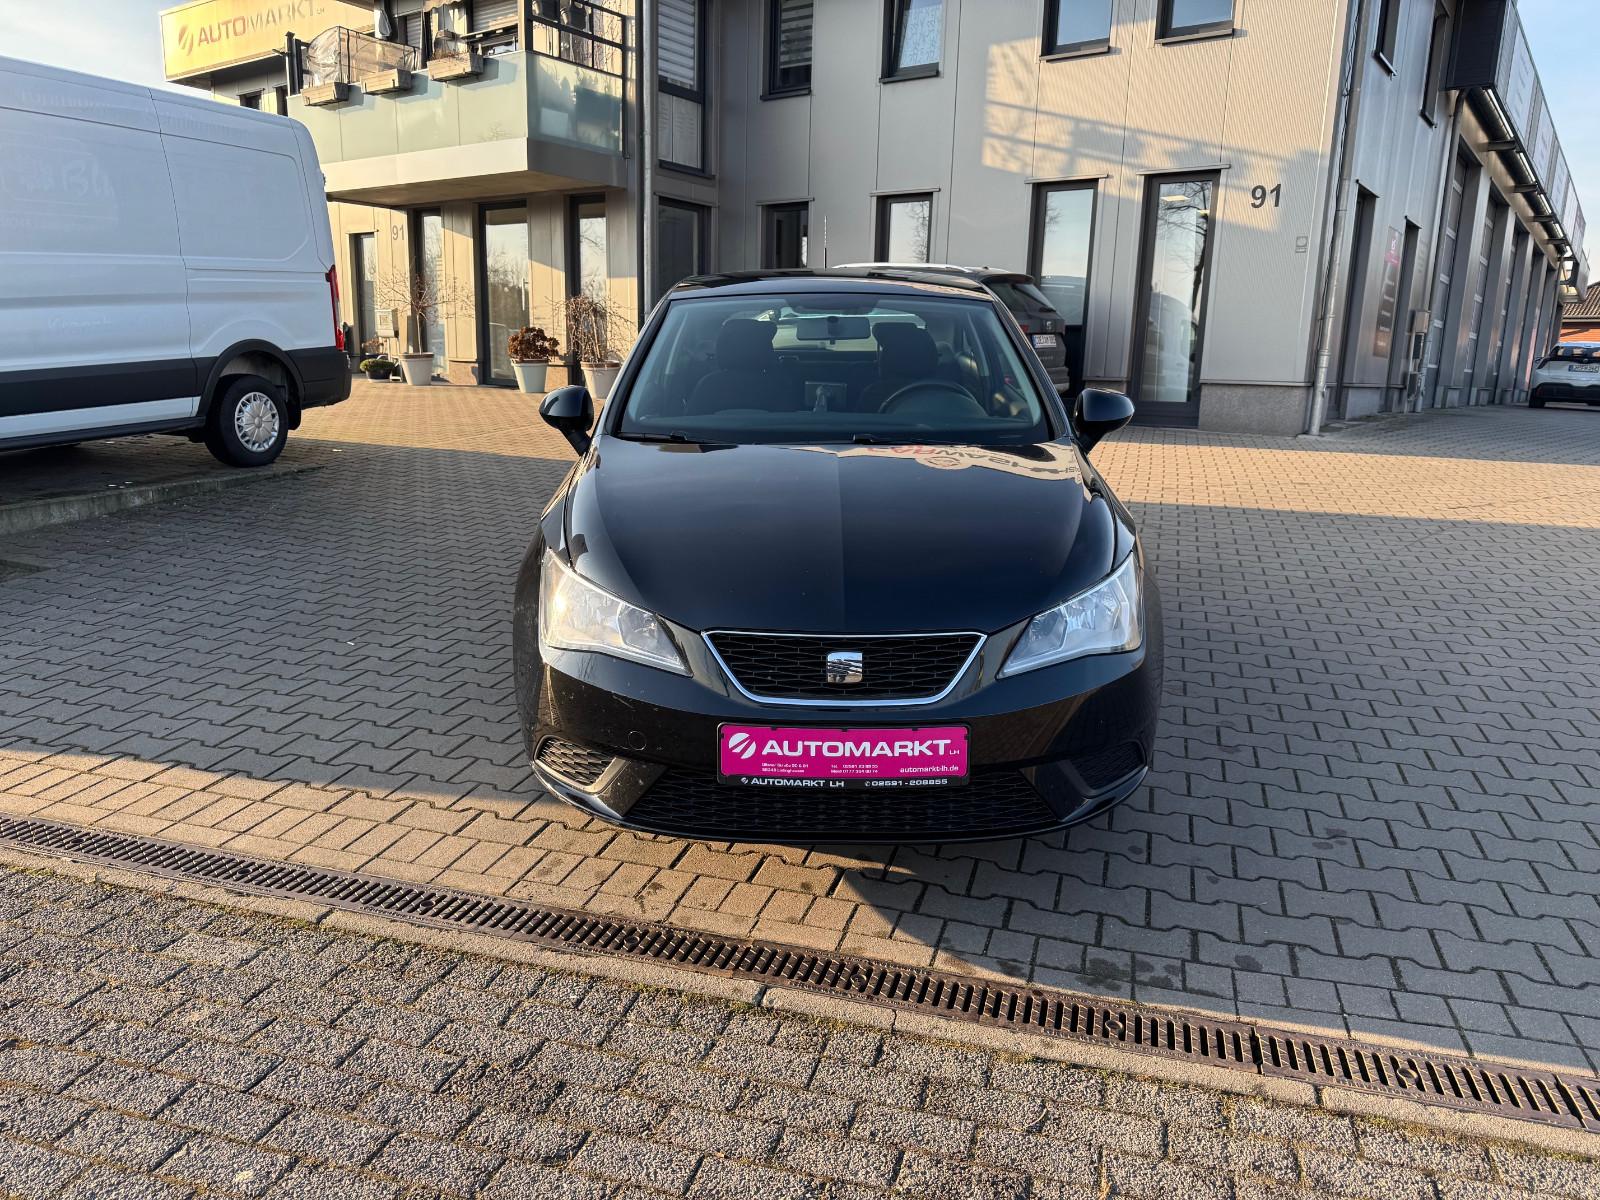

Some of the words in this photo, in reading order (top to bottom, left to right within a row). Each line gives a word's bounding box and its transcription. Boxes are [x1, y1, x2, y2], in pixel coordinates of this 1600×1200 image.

[199, 0, 314, 47] AUTOMARKT
[1250, 183, 1282, 209] 91
[392, 224, 405, 241] 91
[761, 739, 952, 757] AUTOMARKT
[900, 764, 959, 773] automarkt-lh.de
[751, 777, 826, 787] AUTOMARKT
[829, 780, 845, 788] LH
